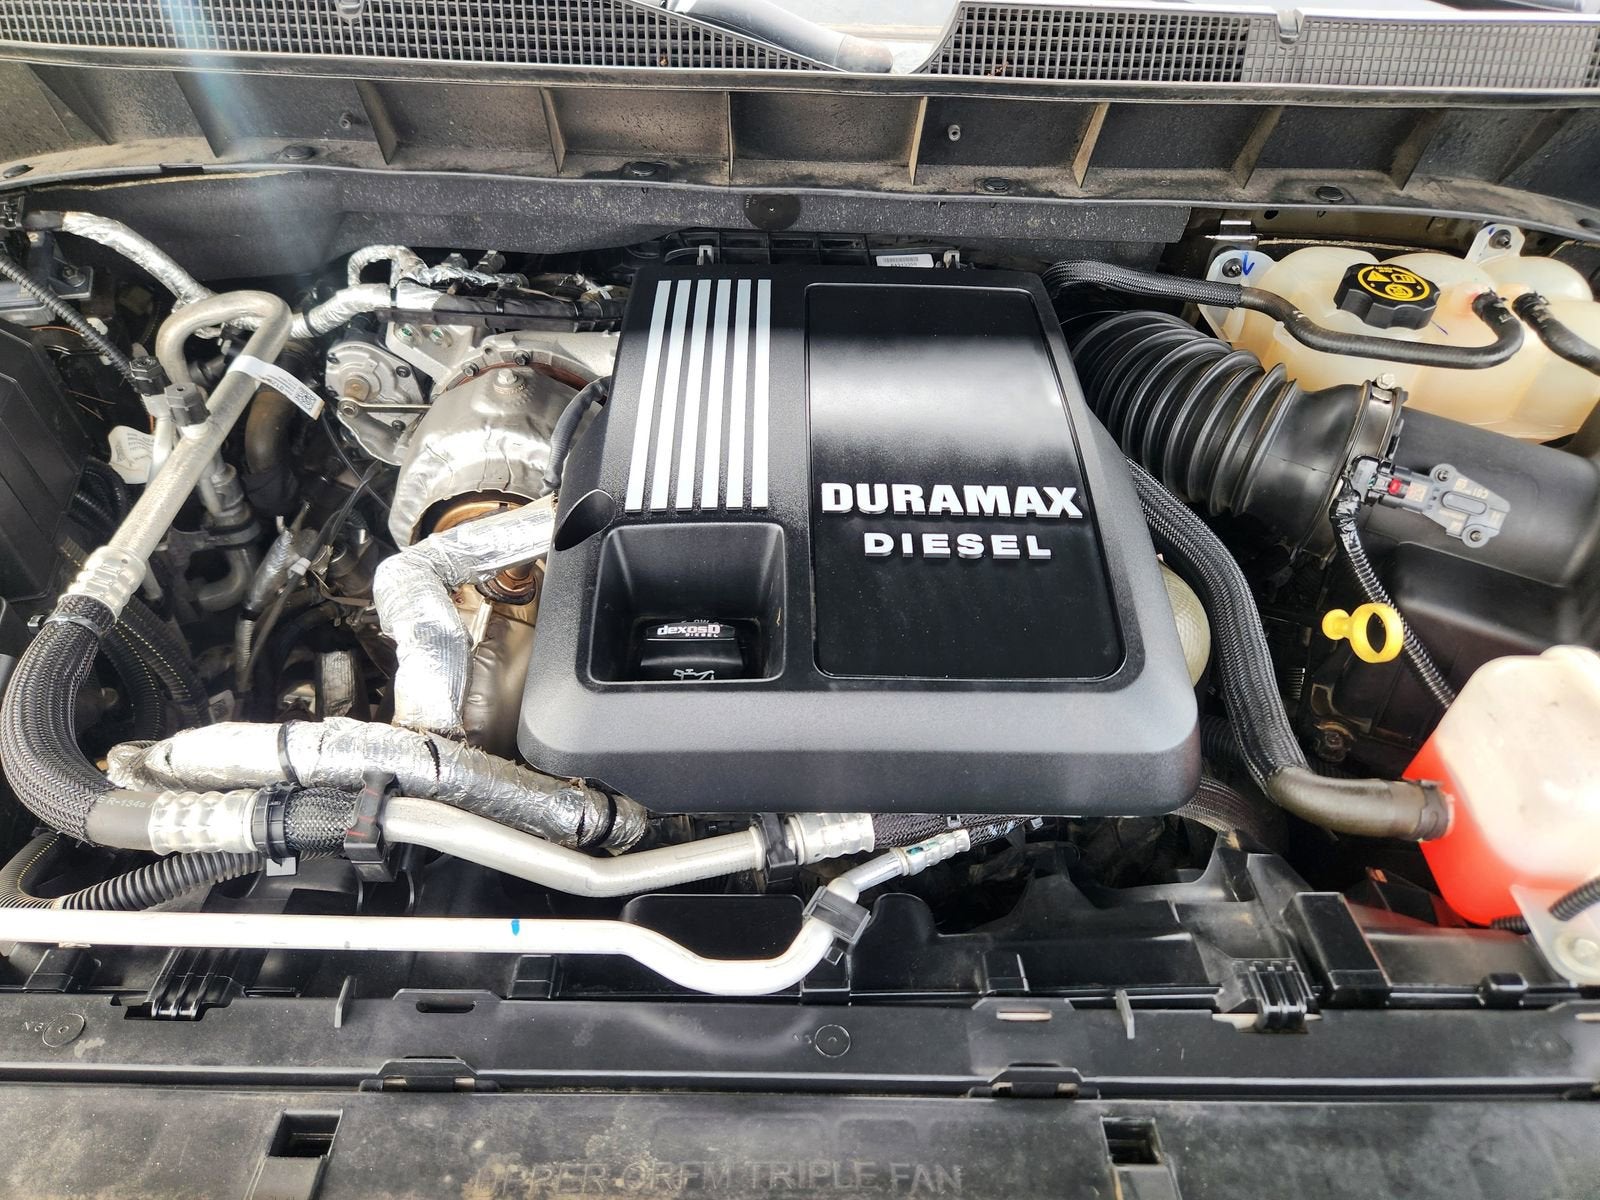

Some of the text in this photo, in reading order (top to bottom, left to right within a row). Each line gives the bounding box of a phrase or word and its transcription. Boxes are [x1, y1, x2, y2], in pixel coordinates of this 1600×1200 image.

[821, 483, 1083, 518] DURAMAX
[864, 533, 1052, 559] DIESEL
[745, 1160, 882, 1191] TRIPLE
[890, 1162, 963, 1194] FAN
